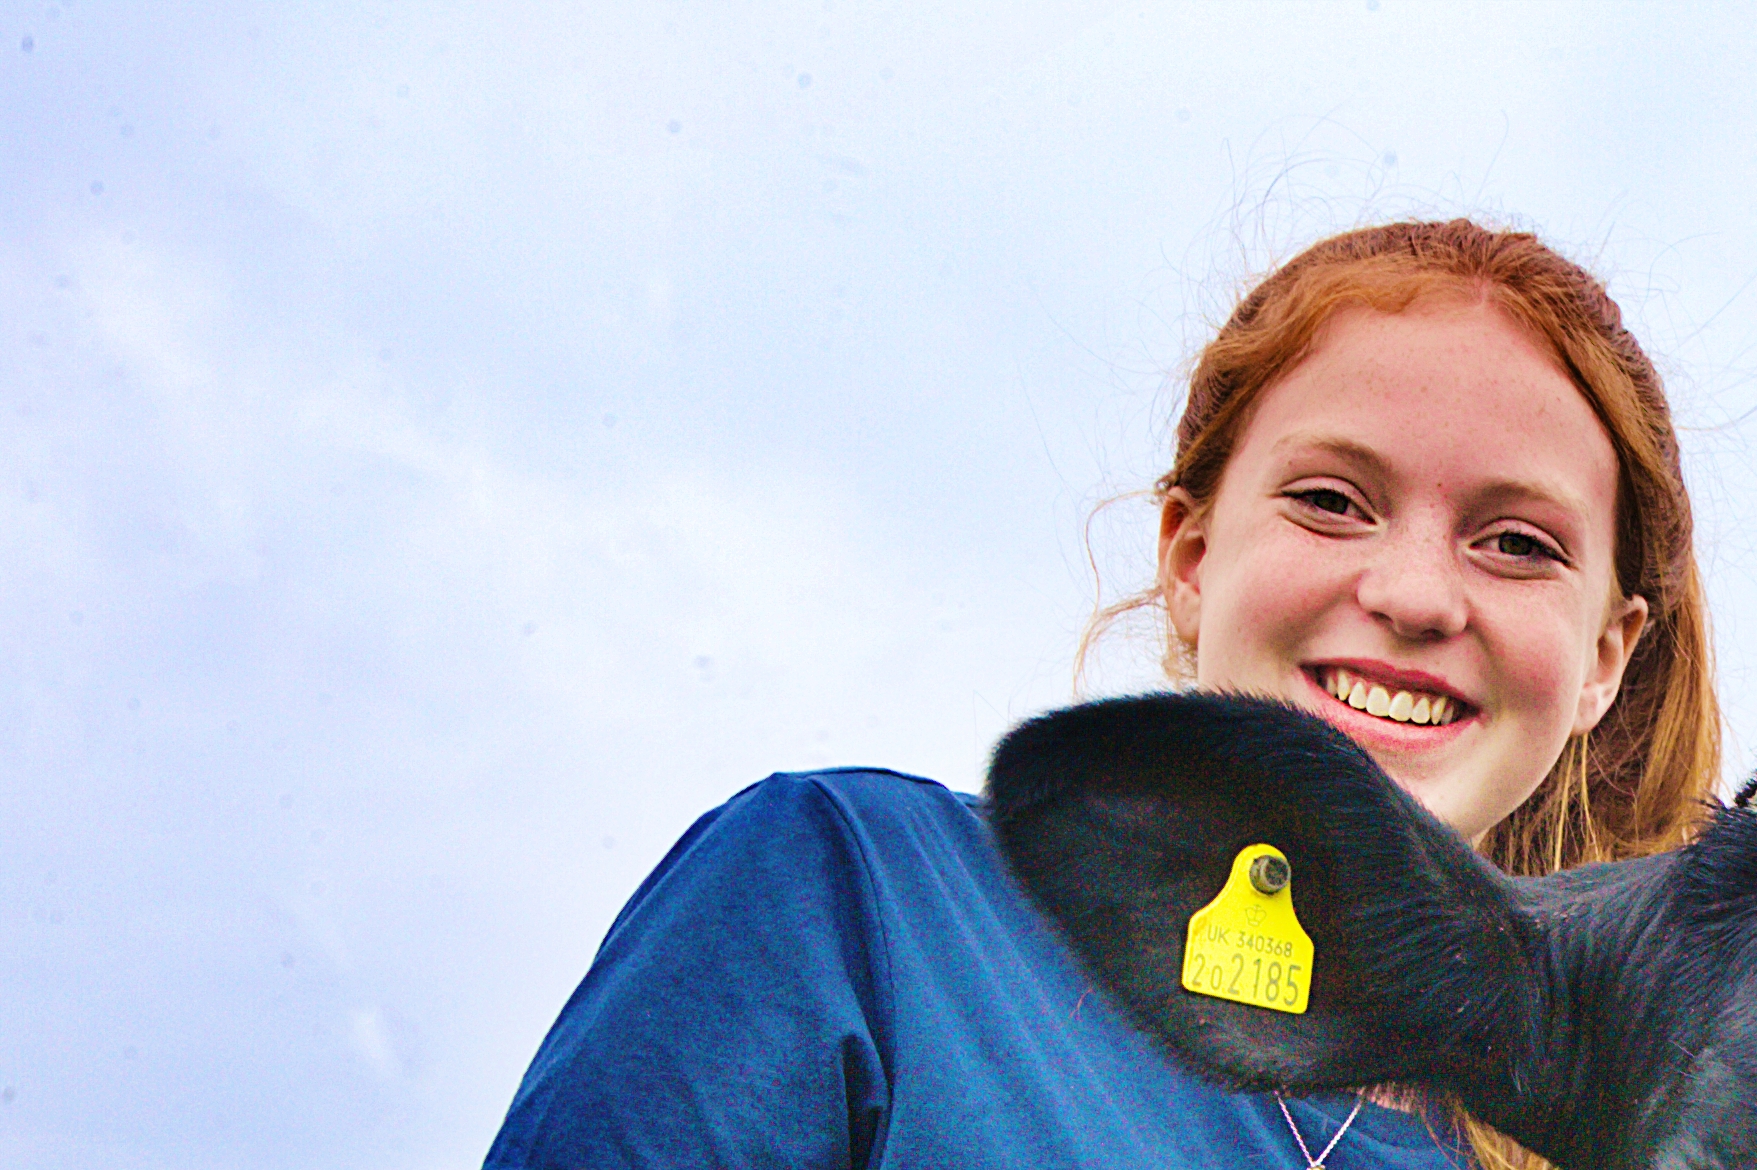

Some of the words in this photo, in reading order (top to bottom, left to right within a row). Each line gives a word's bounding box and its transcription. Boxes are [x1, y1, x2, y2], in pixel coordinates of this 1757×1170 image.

[1207, 925, 1230, 945] UK
[1236, 931, 1294, 958] 340368
[1191, 953, 1302, 1006] 202185
